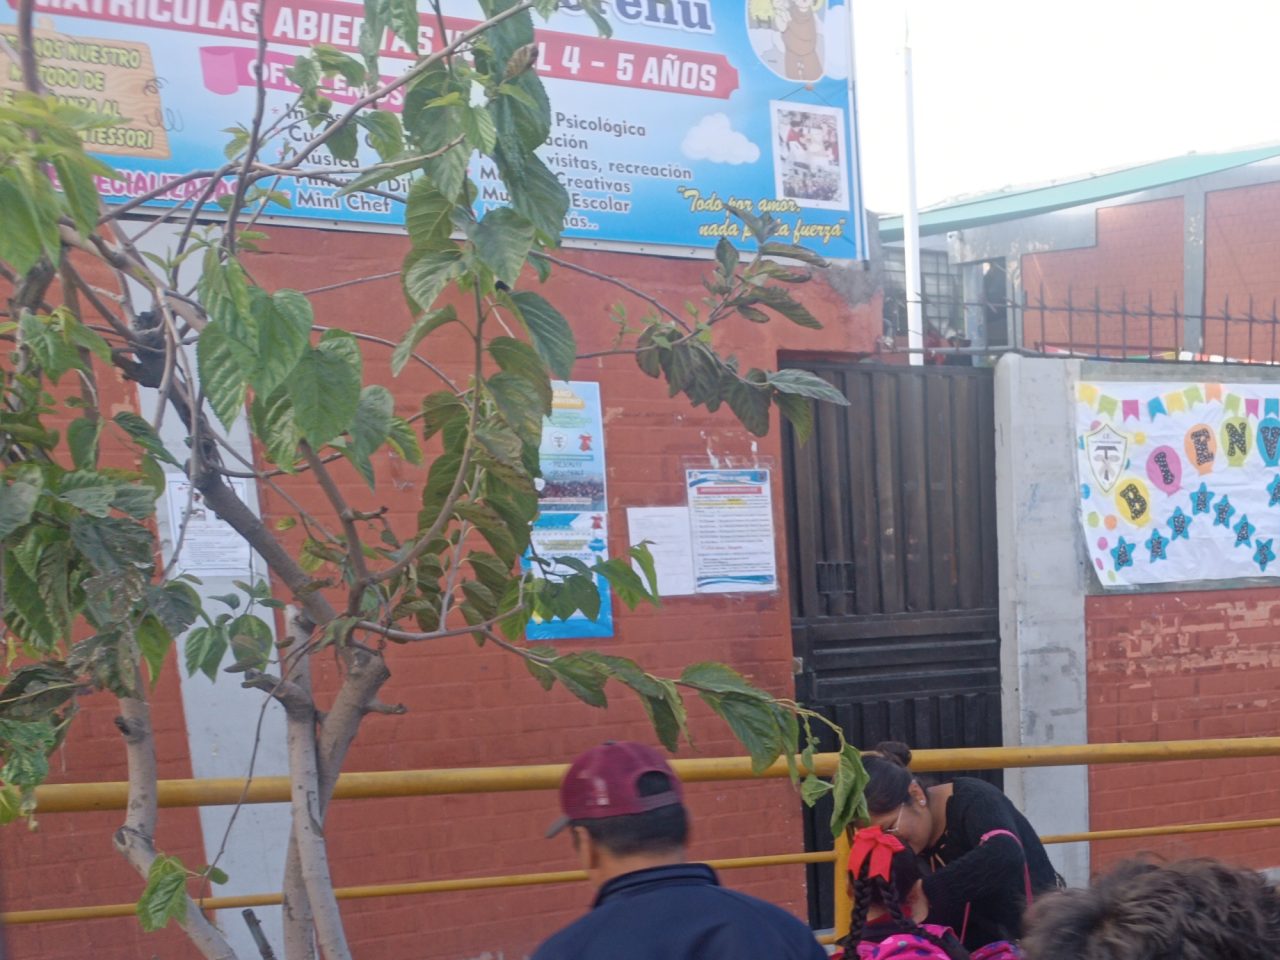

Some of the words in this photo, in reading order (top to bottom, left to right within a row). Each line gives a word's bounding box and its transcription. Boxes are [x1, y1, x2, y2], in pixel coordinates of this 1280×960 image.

[36, 0, 259, 34] RICULAS
[273, 8, 434, 55] ABIEAS
[66, 42, 141, 69] NUESTRO
[9, 63, 80, 88] MTODO
[83, 71, 105, 91] DE
[562, 46, 580, 75] 4
[616, 53, 635, 81] 5
[642, 54, 717, 92] AÑOS
[555, 112, 646, 136] Psicológica
[77, 127, 153, 149] TESSORI
[546, 155, 603, 172] visitas,
[608, 161, 693, 180] recreación
[557, 172, 632, 193] Creativas
[297, 191, 340, 209] Mini
[347, 193, 391, 213] Chef
[571, 192, 630, 213] Escolar
[699, 218, 738, 237] nada
